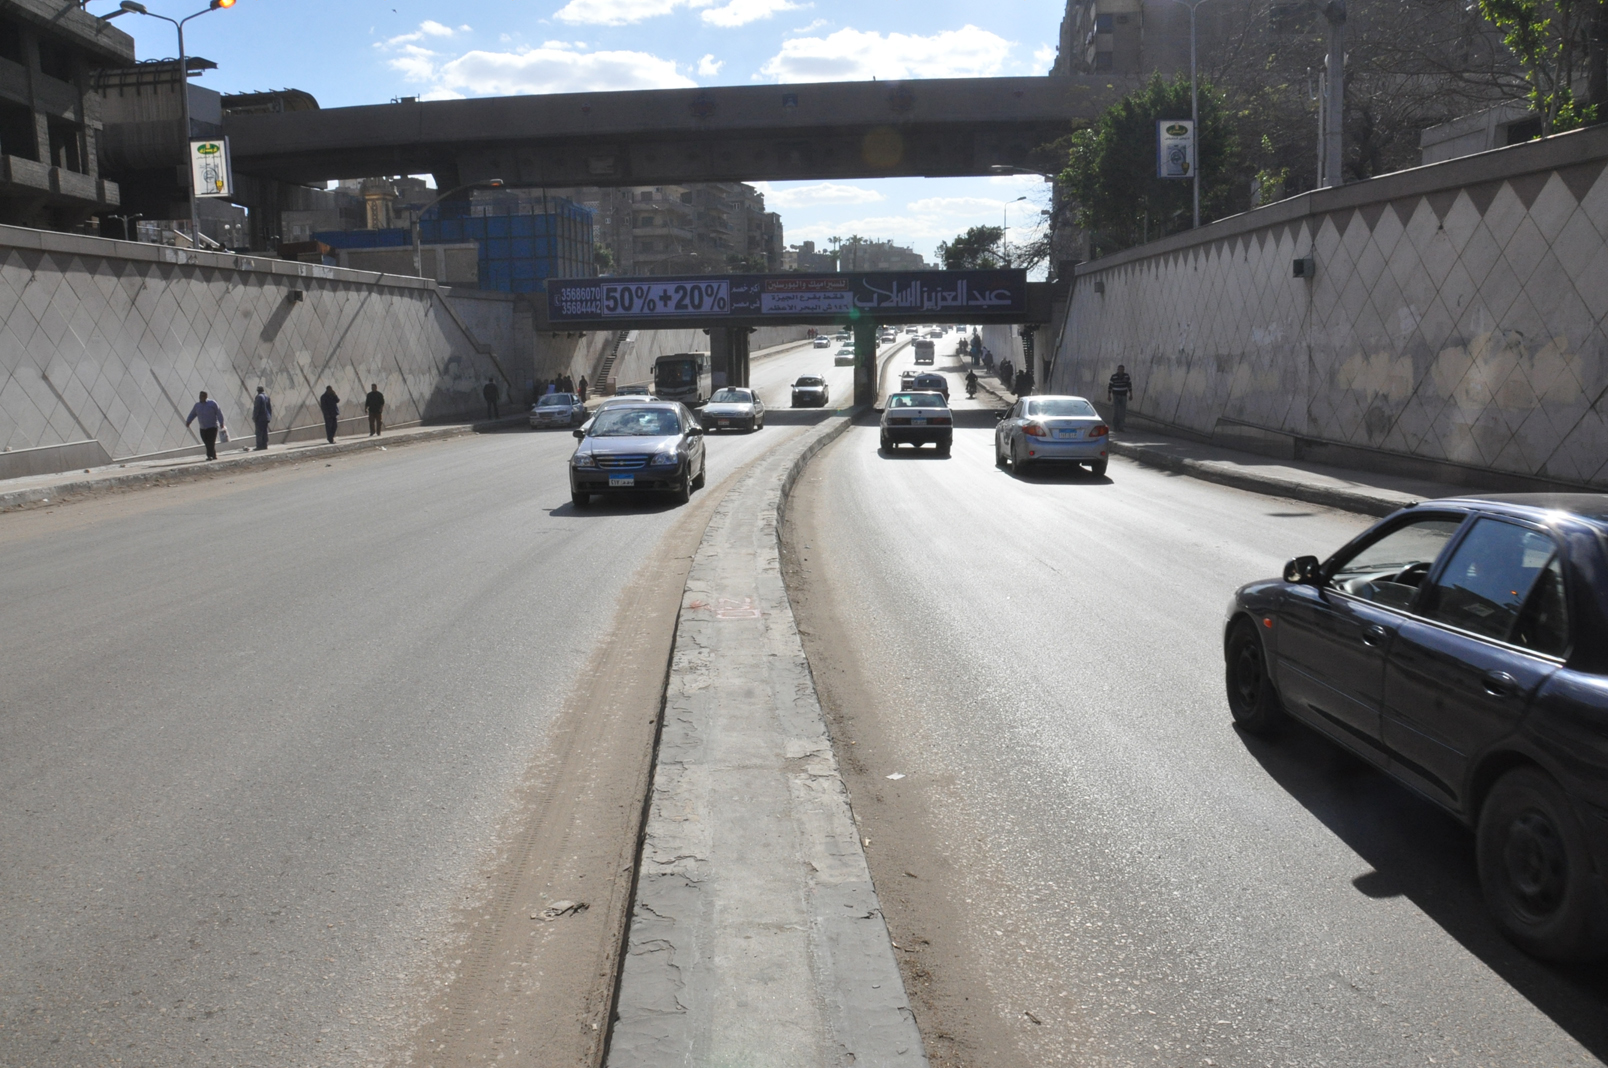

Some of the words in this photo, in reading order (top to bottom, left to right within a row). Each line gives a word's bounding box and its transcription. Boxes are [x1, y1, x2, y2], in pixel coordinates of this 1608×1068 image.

[730, 283, 748, 293] خصم
[768, 280, 806, 291] والبورسلين
[807, 280, 846, 290] للسيراميك
[561, 287, 601, 301] 35686070
[771, 294, 798, 302] الجيزة
[799, 294, 821, 302] بفرع
[854, 277, 921, 311] السلاب
[918, 279, 967, 311] العزيز
[968, 289, 1012, 309] عبد
[562, 301, 601, 314] 35684442
[731, 301, 749, 310] مصر
